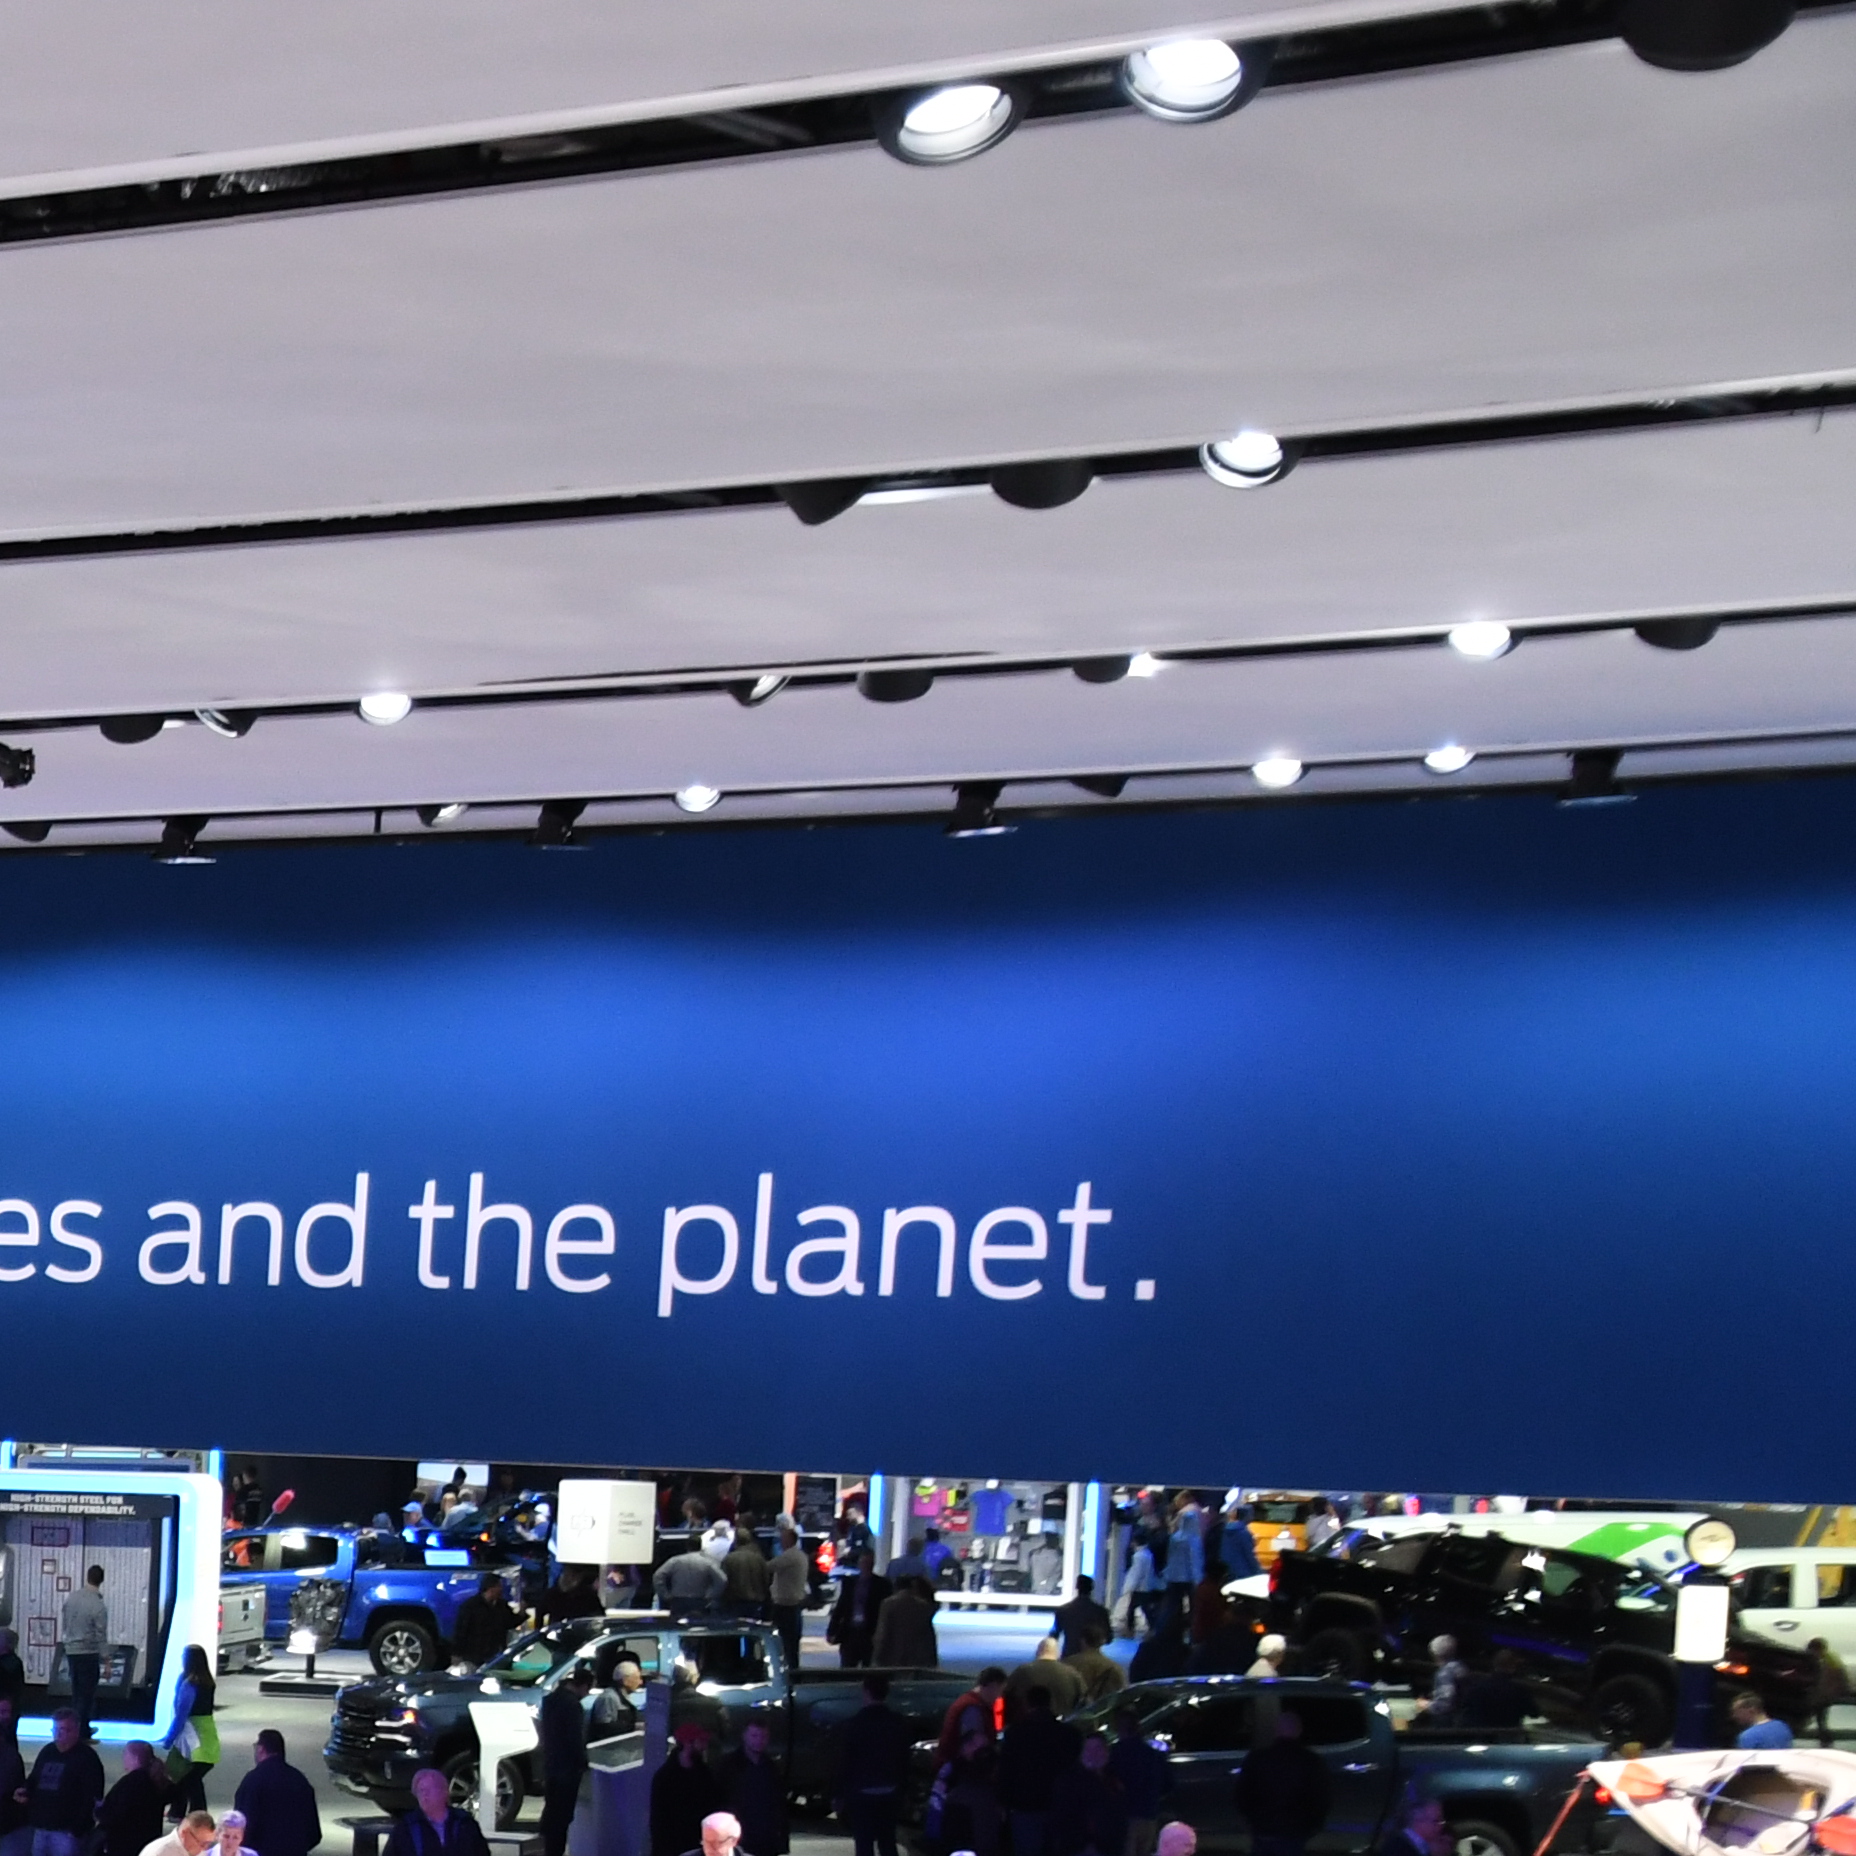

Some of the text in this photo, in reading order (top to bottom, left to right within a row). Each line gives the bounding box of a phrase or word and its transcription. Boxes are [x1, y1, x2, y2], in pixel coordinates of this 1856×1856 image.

[136, 1172, 370, 1289] and
[407, 1172, 616, 1294] the
[656, 1172, 1156, 1318] planet.
